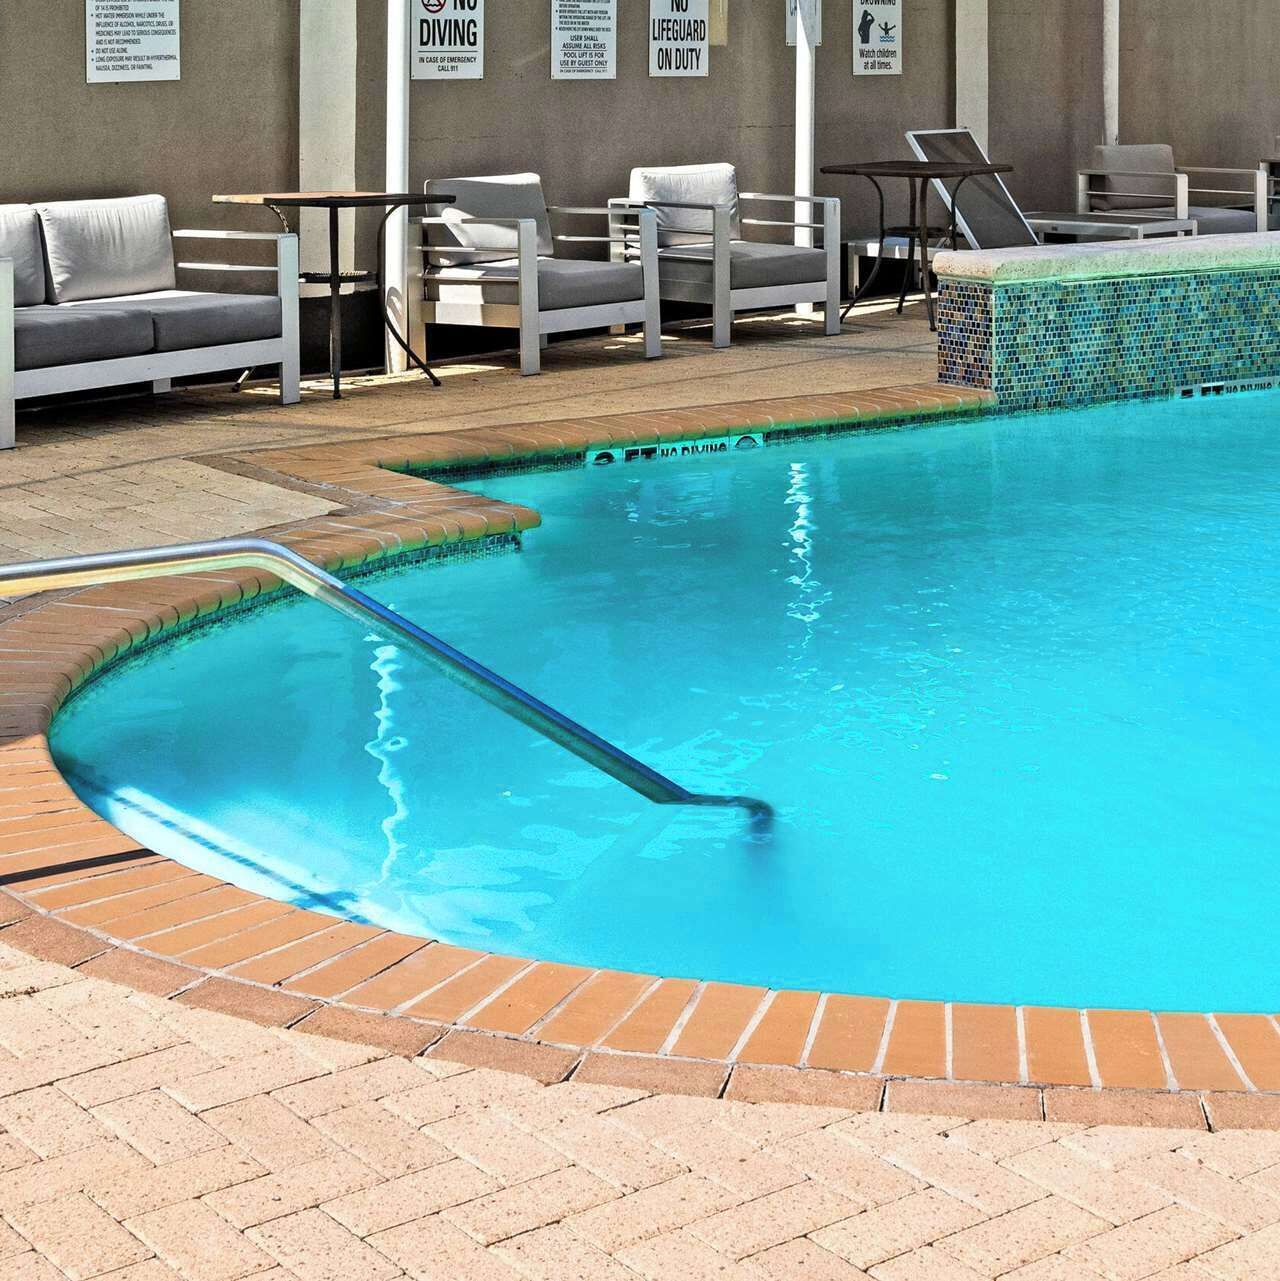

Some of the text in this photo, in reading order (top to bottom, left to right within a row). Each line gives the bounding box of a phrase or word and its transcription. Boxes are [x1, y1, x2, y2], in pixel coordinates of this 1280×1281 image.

[420, 19, 477, 46] DIVING
[653, 18, 705, 41] LIFEGUARD
[658, 48, 701, 70] ON DUTY
[859, 48, 897, 58] Watch children
[864, 60, 869, 70] at
